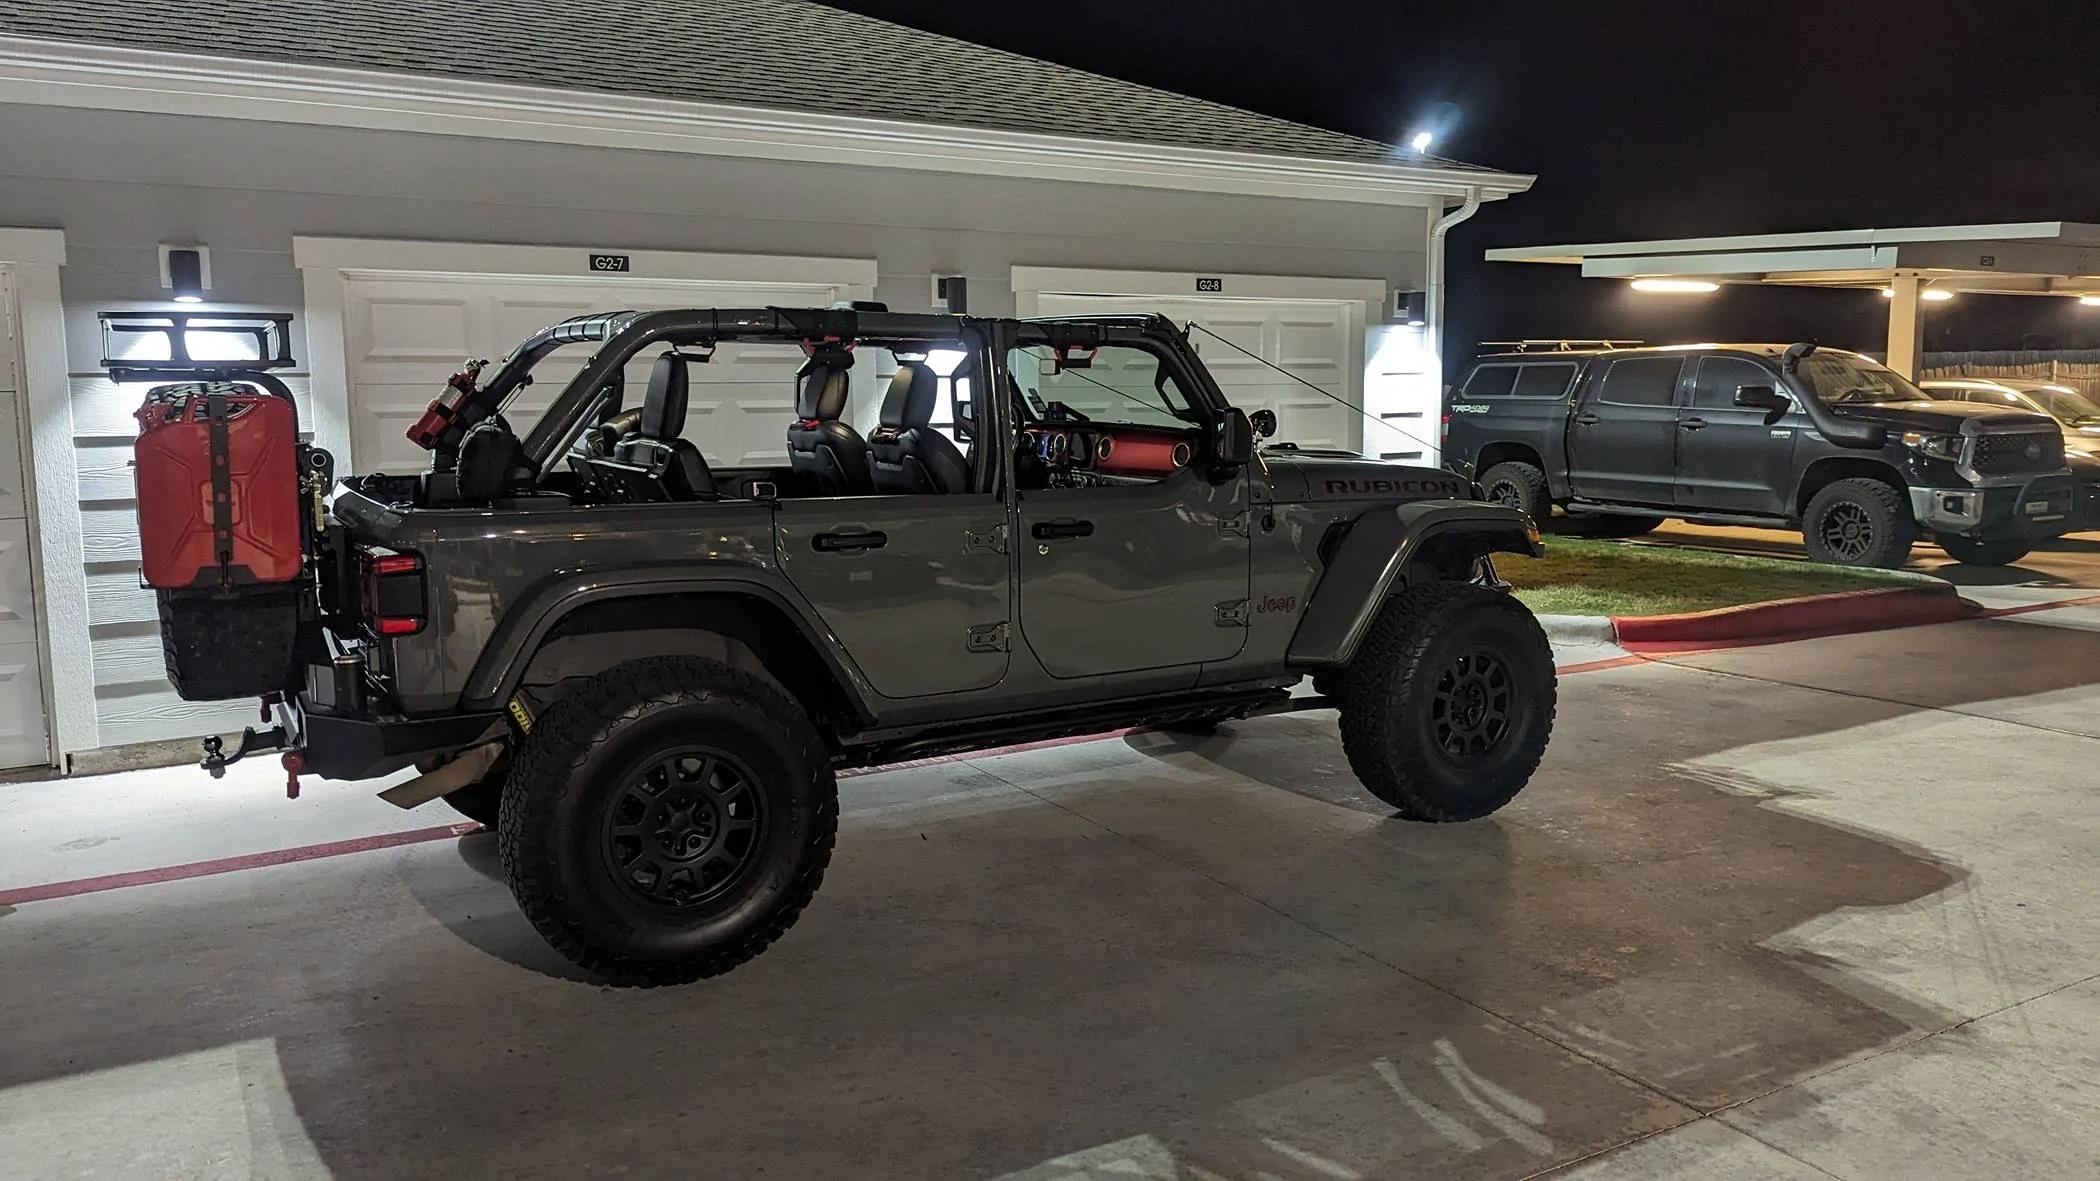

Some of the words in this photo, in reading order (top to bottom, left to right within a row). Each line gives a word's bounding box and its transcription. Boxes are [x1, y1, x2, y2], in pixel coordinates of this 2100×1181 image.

[595, 257, 624, 270] G2-7
[1200, 280, 1219, 291] G2-8
[1325, 480, 1460, 495] RUBICON
[1257, 595, 1296, 614] Jeep
[835, 754, 948, 778] ARKING
